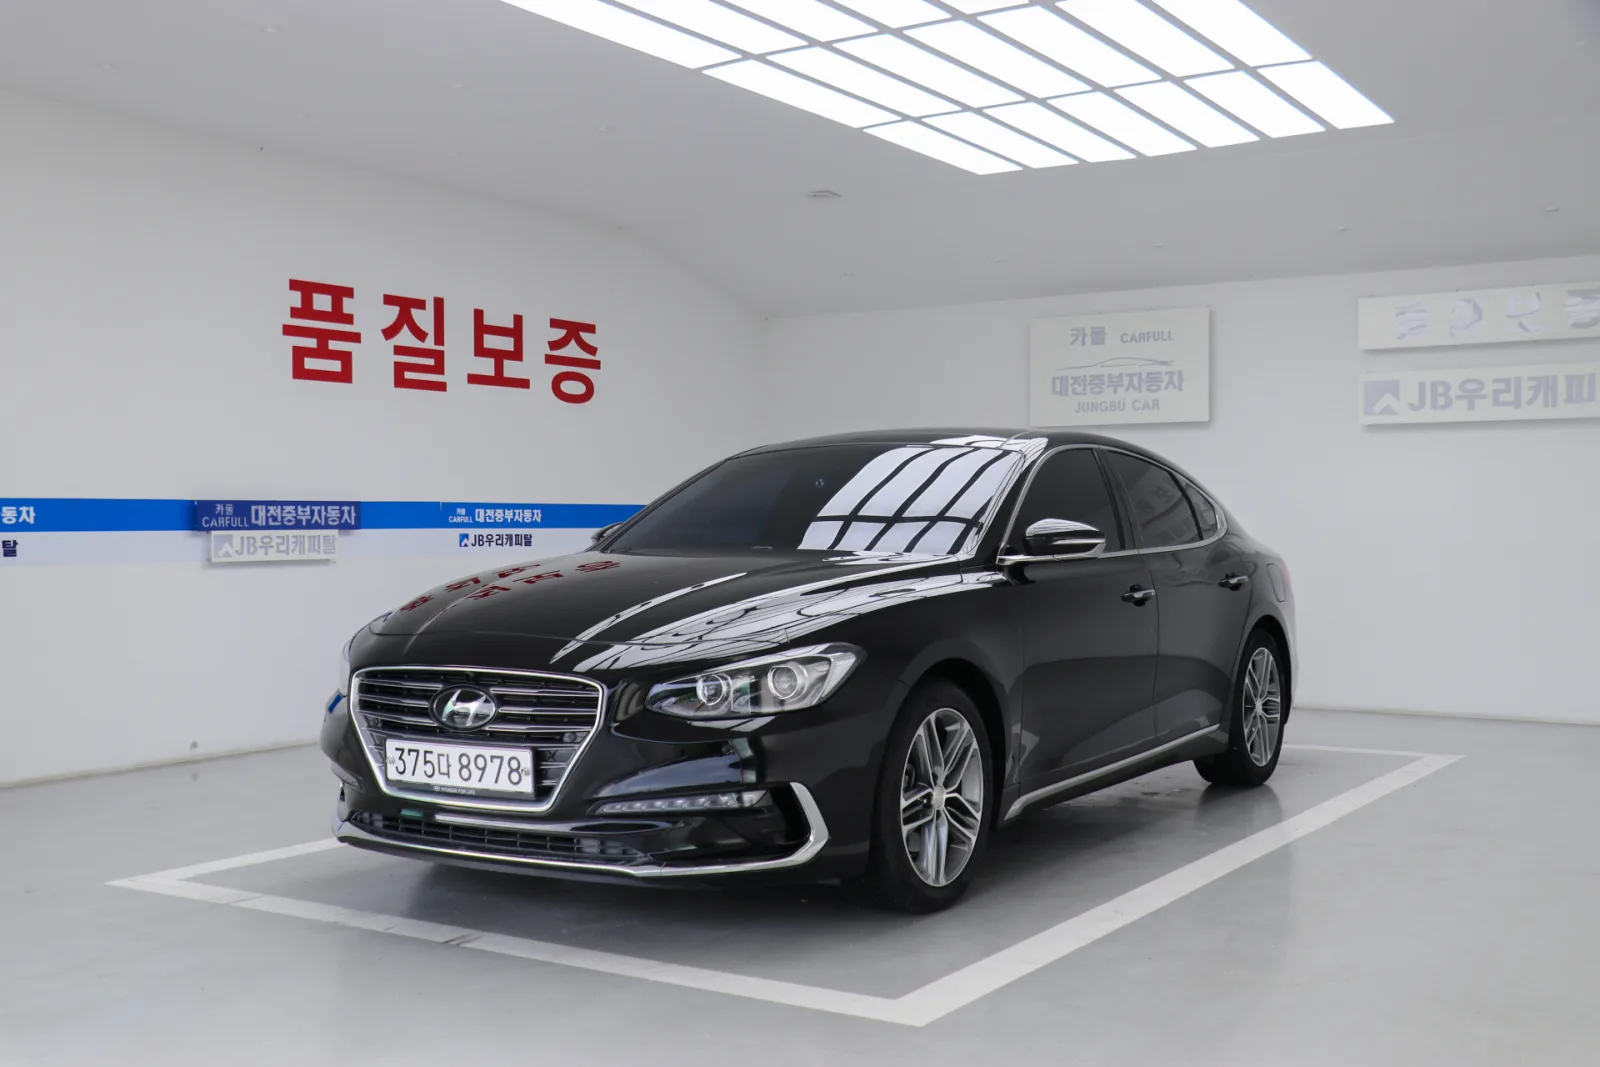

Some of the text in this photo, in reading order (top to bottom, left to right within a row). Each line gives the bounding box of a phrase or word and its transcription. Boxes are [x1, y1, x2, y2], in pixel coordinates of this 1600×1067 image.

[282, 278, 601, 404] 품질보증
[1120, 330, 1174, 344] CARFULL
[1051, 370, 1184, 397] 대전중부자동차
[1074, 399, 1160, 413] JUNGBU CAR
[202, 516, 249, 528] CARFULL
[251, 505, 357, 526] 대전중부자동차
[475, 508, 542, 523] 대전중부자동차
[234, 534, 337, 556] JB우리캐피탈
[471, 533, 533, 547] JB우리캐피탈
